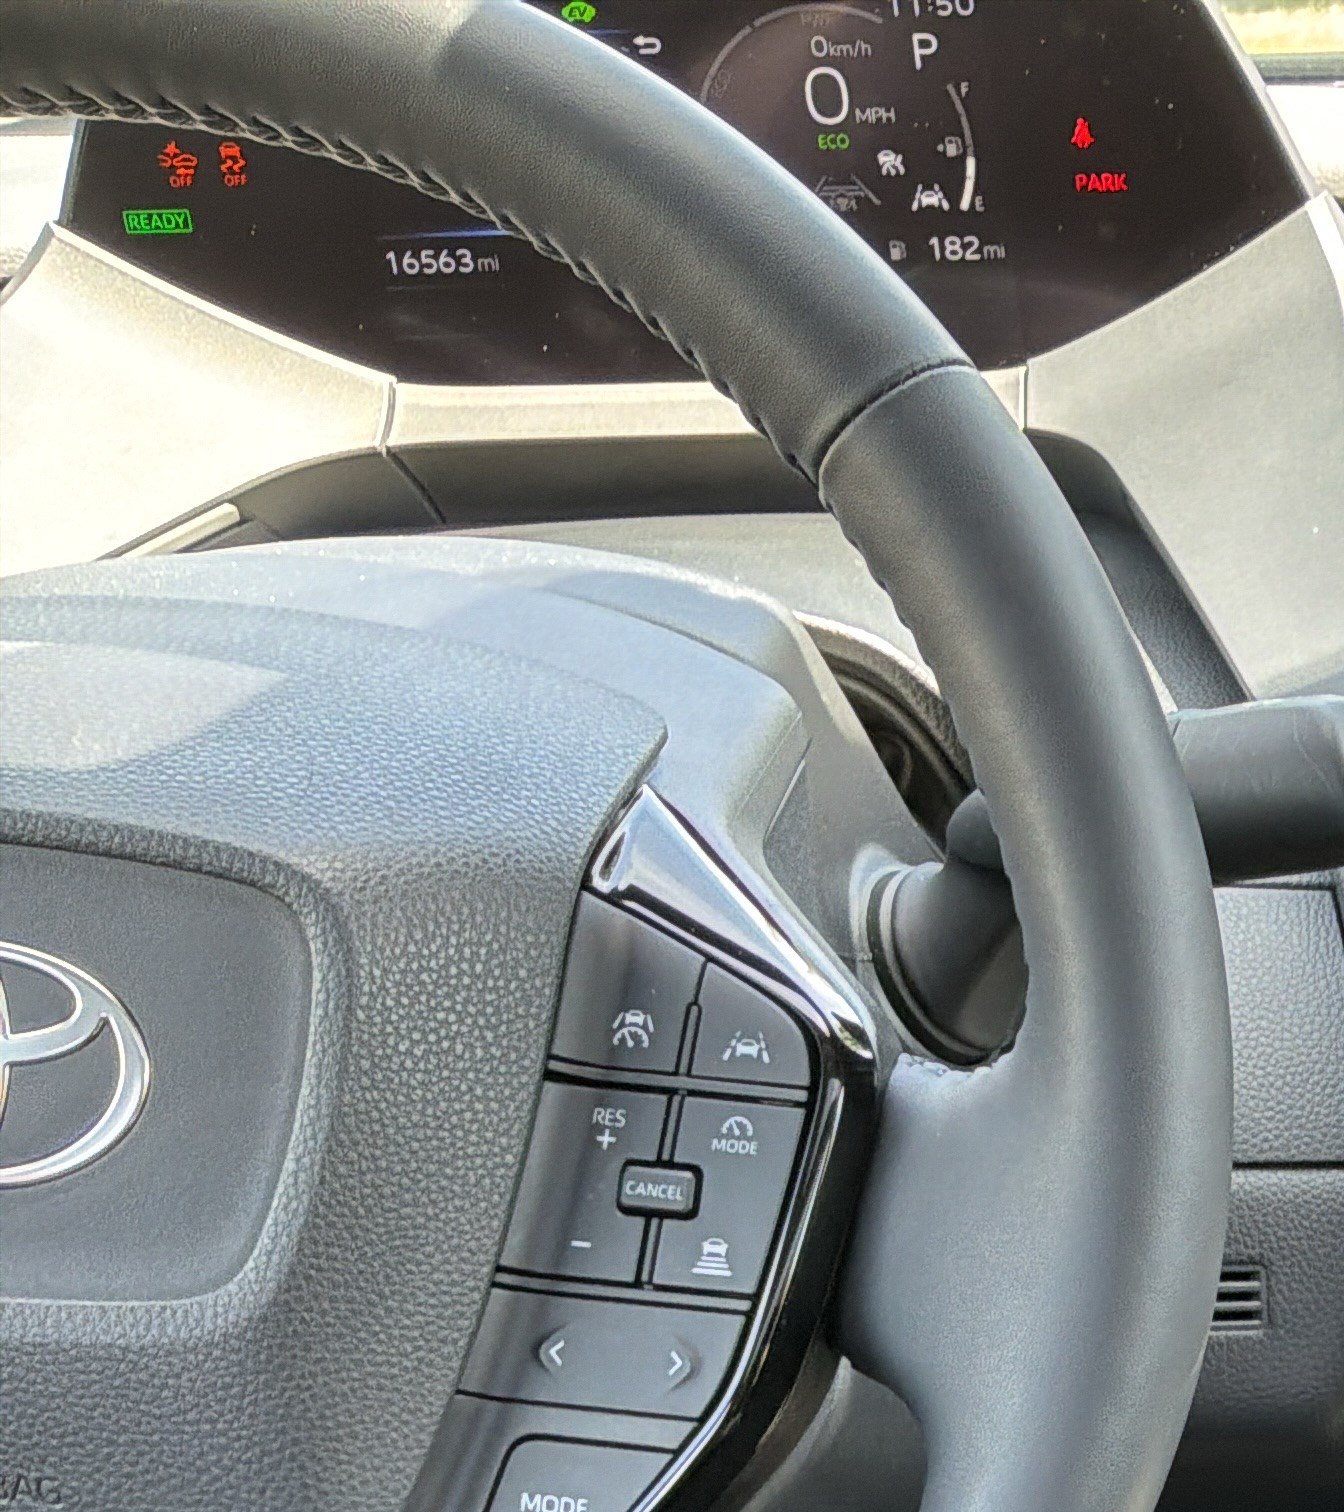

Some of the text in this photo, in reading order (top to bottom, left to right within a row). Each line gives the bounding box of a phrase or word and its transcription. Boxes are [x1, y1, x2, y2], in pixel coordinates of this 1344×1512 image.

[911, 32, 939, 71] P
[805, 66, 896, 126] 0 MPH
[817, 133, 850, 150] ECO
[169, 175, 193, 188] OFF
[224, 174, 248, 187] OFF
[1075, 172, 1129, 192] PARK
[127, 213, 186, 230] READY
[591, 1107, 627, 1128] RES
[710, 1137, 759, 1155] MODE
[624, 1180, 685, 1201] CANCEL
